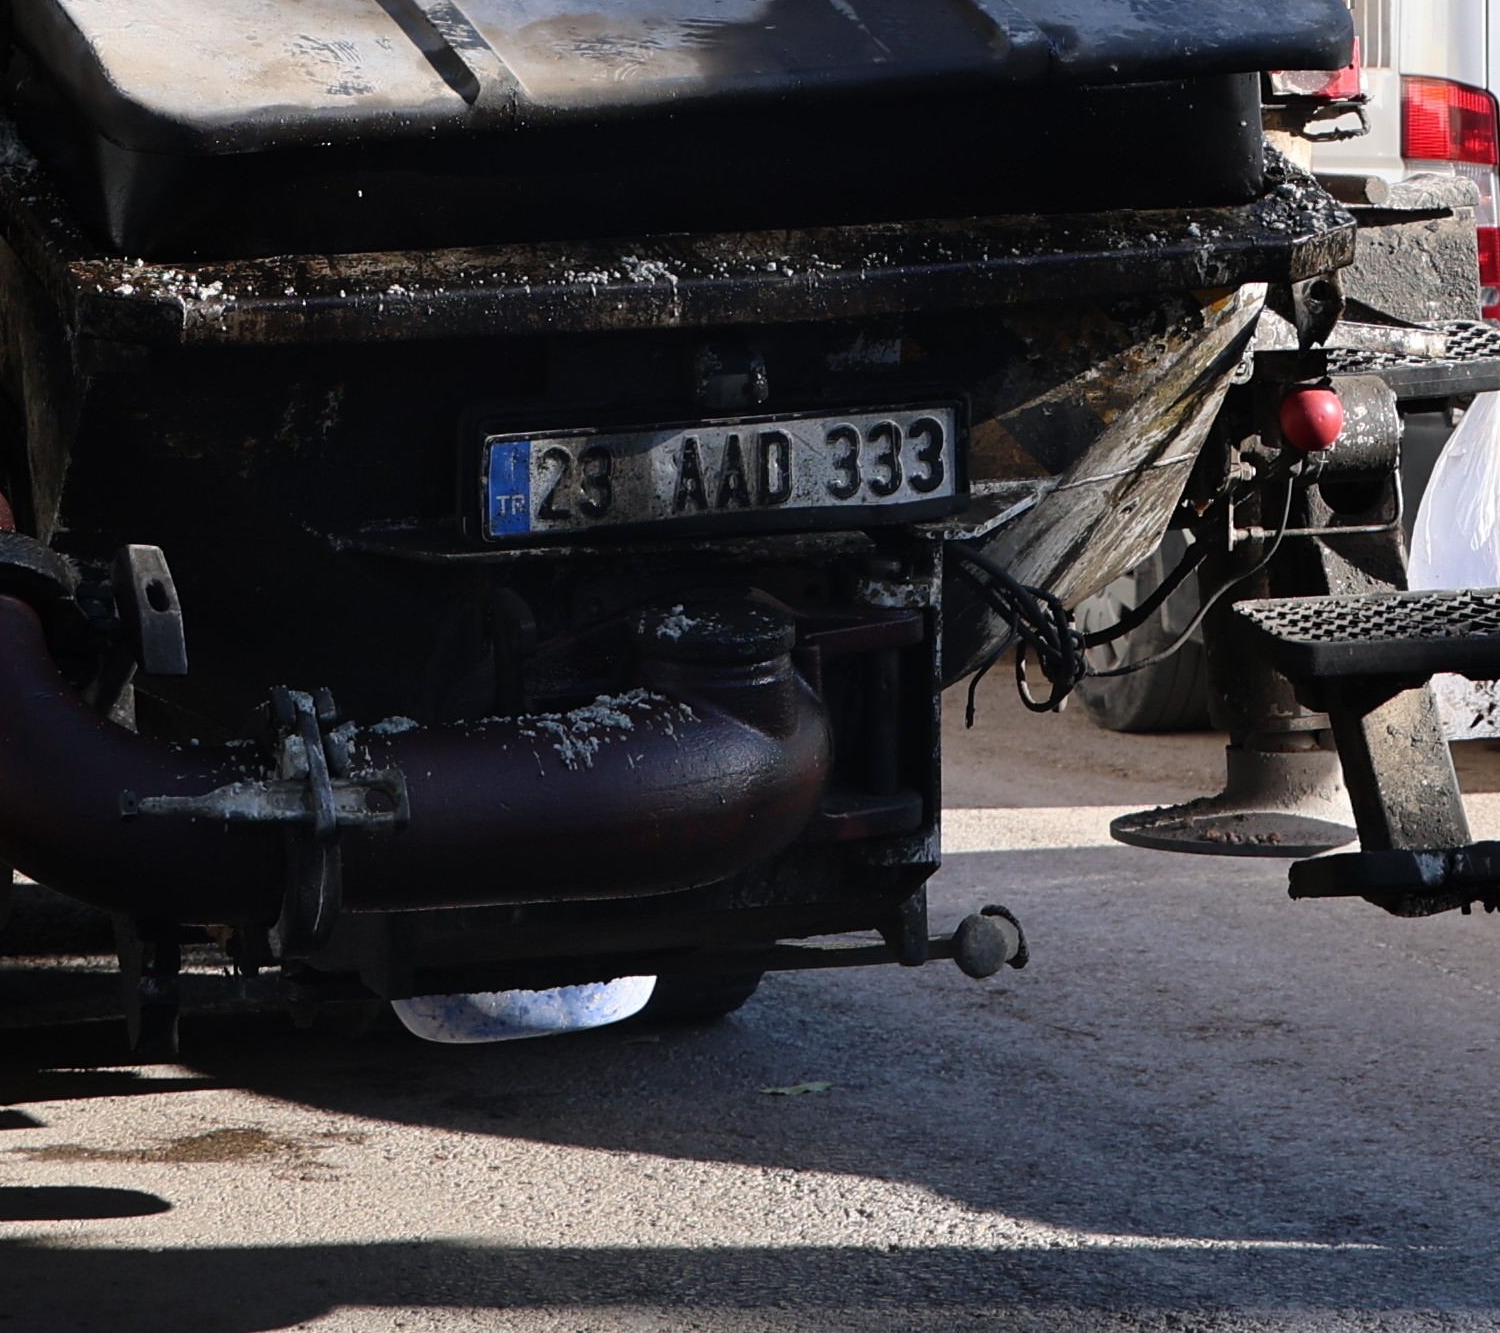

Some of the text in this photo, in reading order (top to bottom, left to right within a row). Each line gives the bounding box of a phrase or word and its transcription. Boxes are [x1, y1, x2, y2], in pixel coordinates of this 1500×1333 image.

[536, 416, 945, 520] 23 AAD 333
[496, 495, 525, 516] TR
